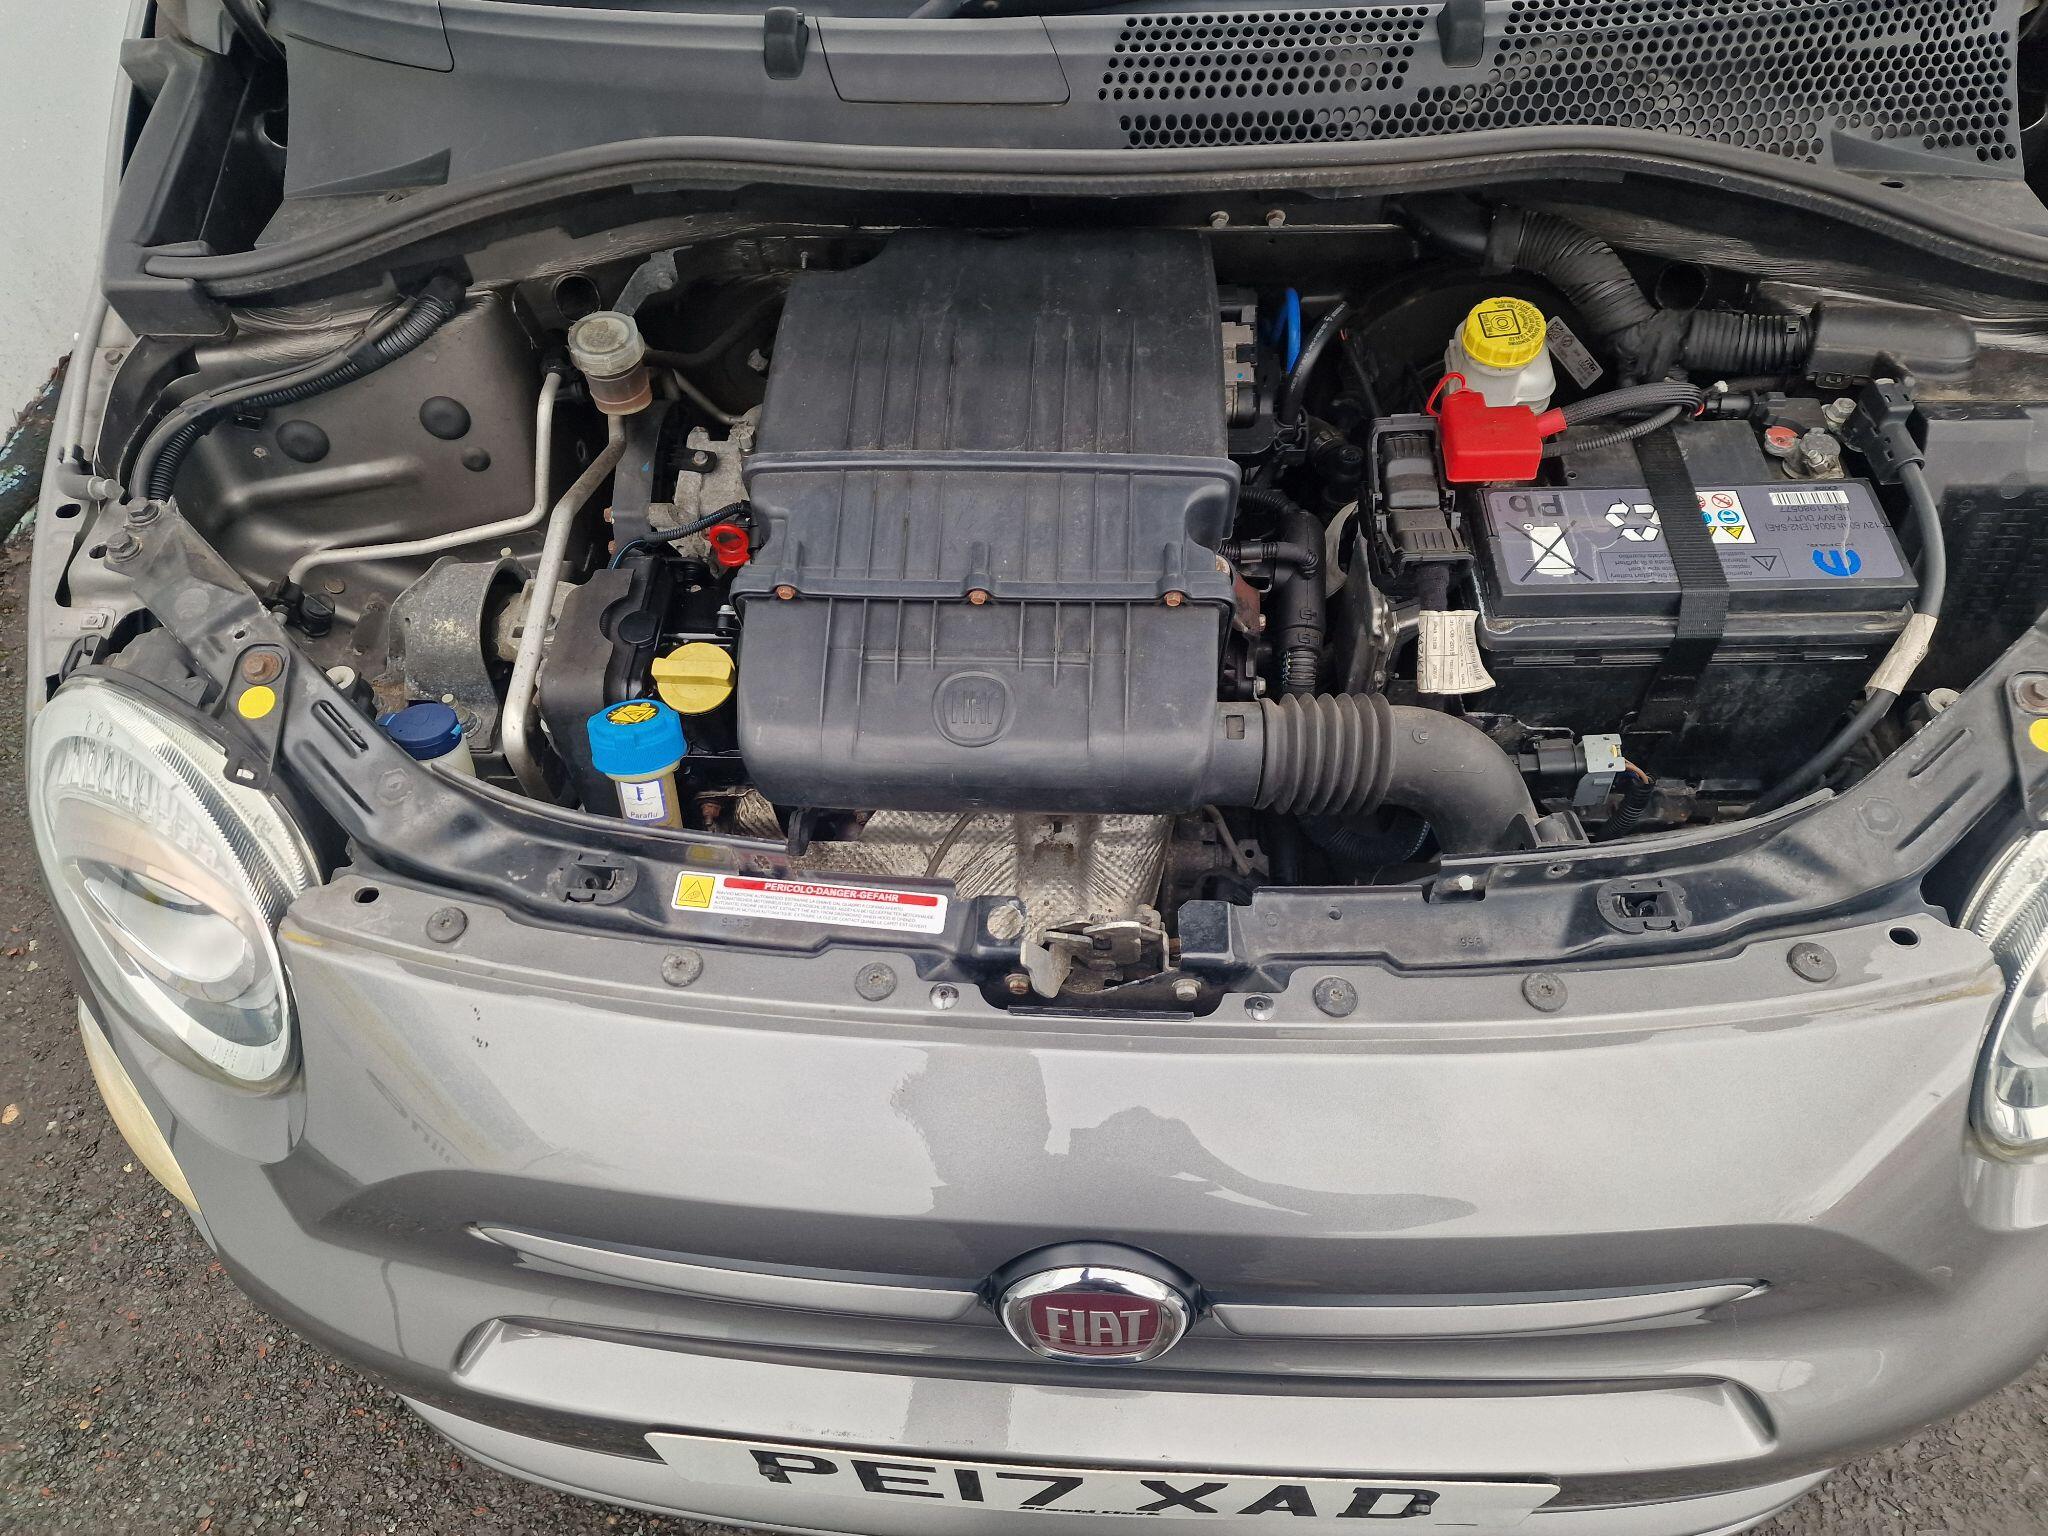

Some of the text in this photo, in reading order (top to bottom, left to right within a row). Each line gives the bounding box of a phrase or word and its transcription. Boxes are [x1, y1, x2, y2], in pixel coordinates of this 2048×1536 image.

[1508, 494, 1565, 517] Pb
[1778, 505, 1828, 513] 51980577
[1786, 514, 1815, 522] DUTY
[764, 882, 899, 902] PERICOLO-DANGER-GEFAHR
[1046, 1306, 1150, 1346] FIAT
[749, 1449, 1441, 1519] PE17 XAD
